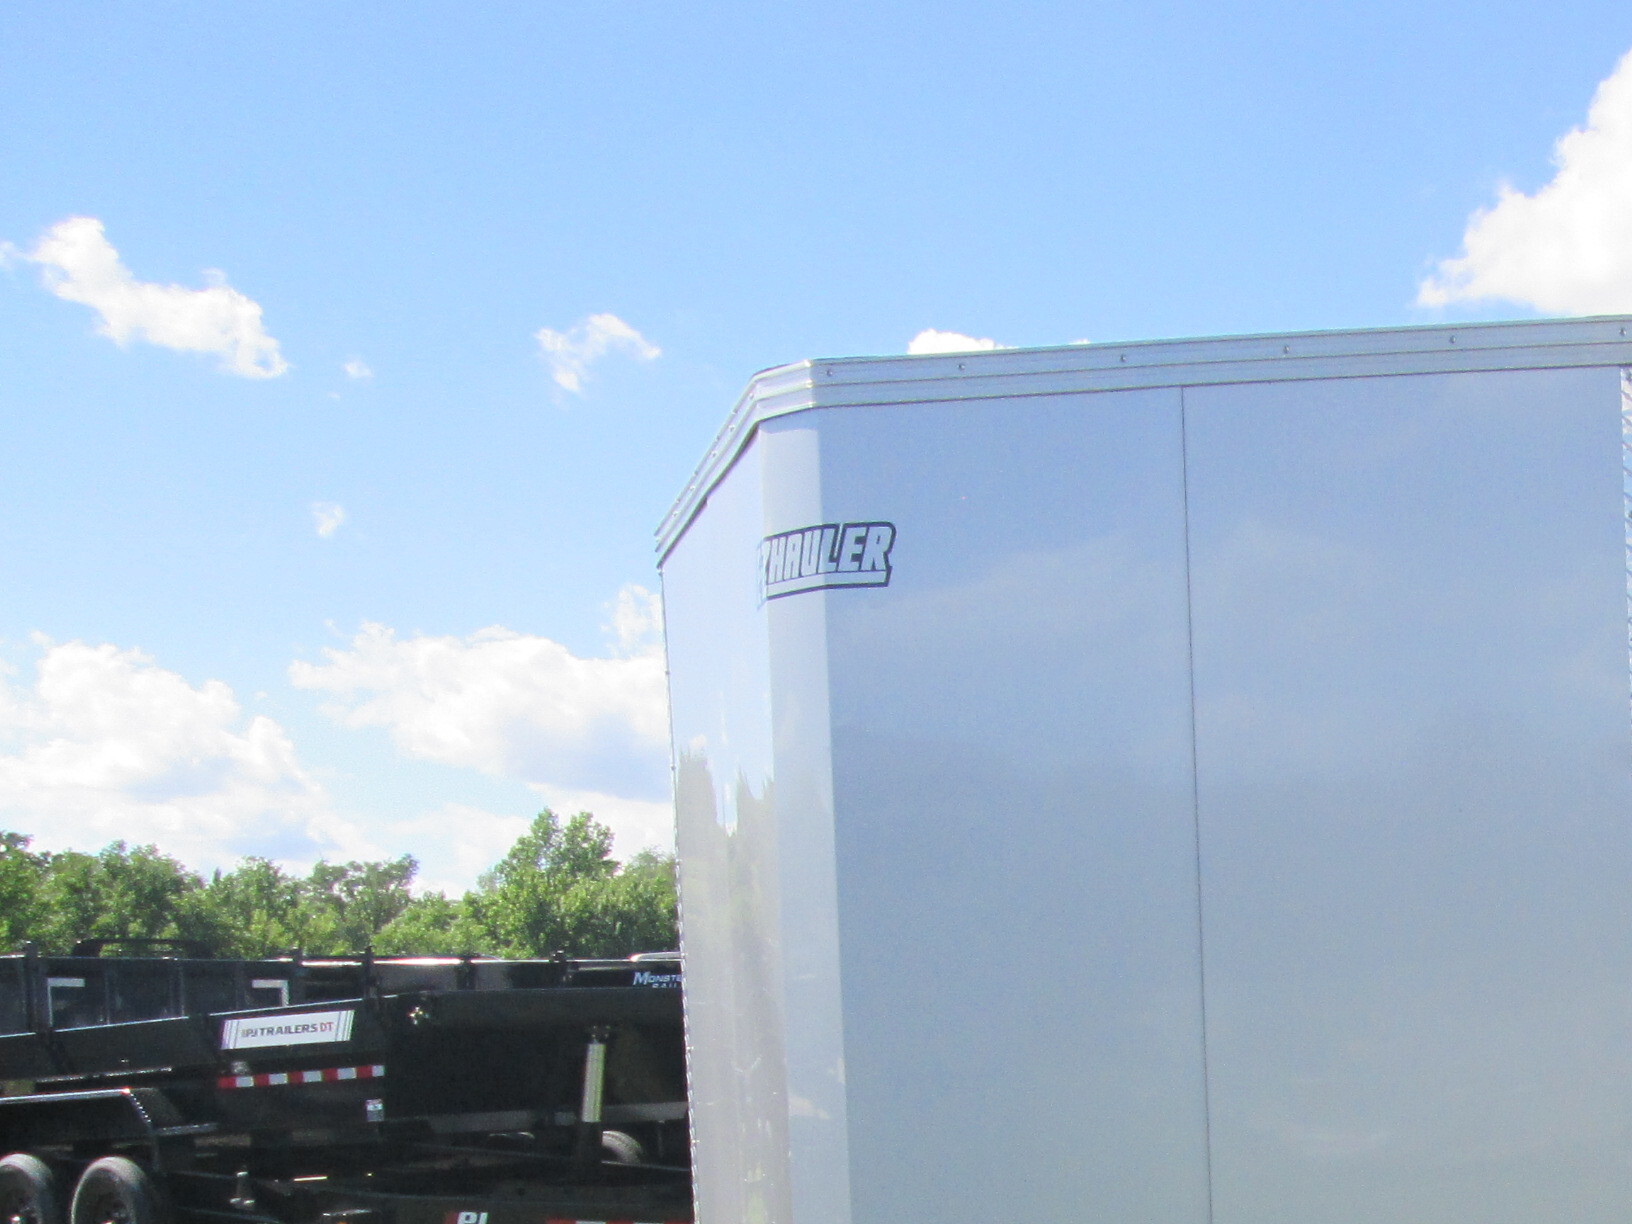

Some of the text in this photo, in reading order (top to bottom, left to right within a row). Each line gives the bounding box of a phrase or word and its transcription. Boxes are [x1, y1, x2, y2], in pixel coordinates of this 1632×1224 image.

[633, 968, 683, 985] MONSTE
[259, 1023, 318, 1037] TRAILERS
[319, 1021, 335, 1032] DT
